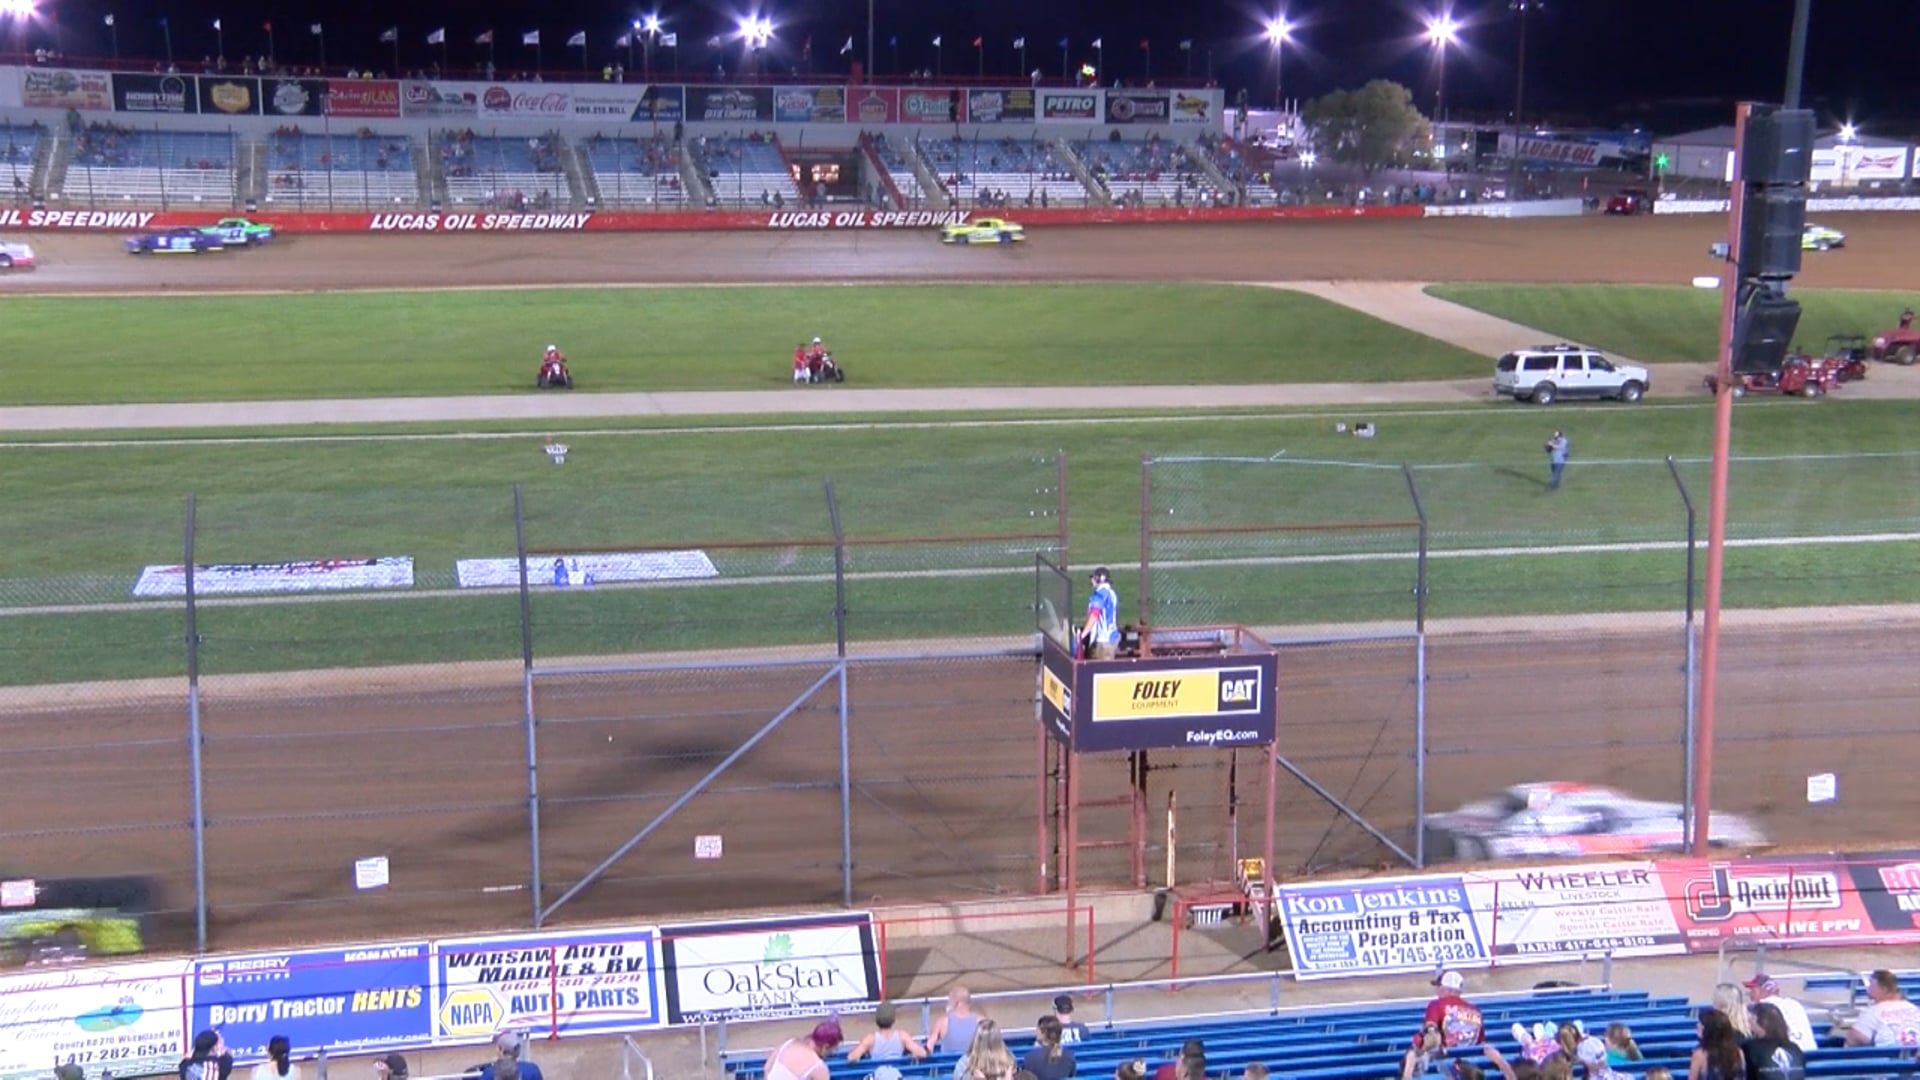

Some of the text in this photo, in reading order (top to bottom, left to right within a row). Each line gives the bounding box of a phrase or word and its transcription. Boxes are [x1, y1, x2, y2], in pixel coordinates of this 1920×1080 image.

[1047, 96, 1094, 111] PETRO
[1520, 139, 1597, 164] LUCAS OIL
[27, 211, 154, 227] SPEEDWAY
[370, 213, 591, 230] LUCAS OIL SPEEDWAY
[768, 211, 971, 228] LUCAS OIL SPEEDWAY
[1132, 680, 1182, 700] FOLEY
[1221, 679, 1256, 703] CAT
[1131, 700, 1179, 710] EQUIPMENT
[1186, 729, 1259, 746] FoleyEQ.com
[1516, 869, 1651, 891] WHEELER
[1285, 885, 1462, 916] Ron Jenkins
[1559, 890, 1622, 902] LIVESTOCK
[1299, 910, 1461, 934] Accounting & Tax
[1778, 920, 1819, 935] LIVE
[1822, 918, 1861, 933] PPV
[1358, 926, 1467, 949] Preparation
[227, 957, 291, 970] BERRY
[448, 944, 624, 969] WARSAW AUTO
[1361, 942, 1477, 966] 417-745-2328
[477, 956, 644, 983] MARINE & RV
[703, 962, 840, 996] OakStar
[210, 986, 423, 1025] Berry Tractor RENTS
[450, 987, 640, 1026] NAPA AUTO PARTS
[747, 991, 801, 1005] BANK
[53, 1041, 178, 1067] 1-417-282-6544
